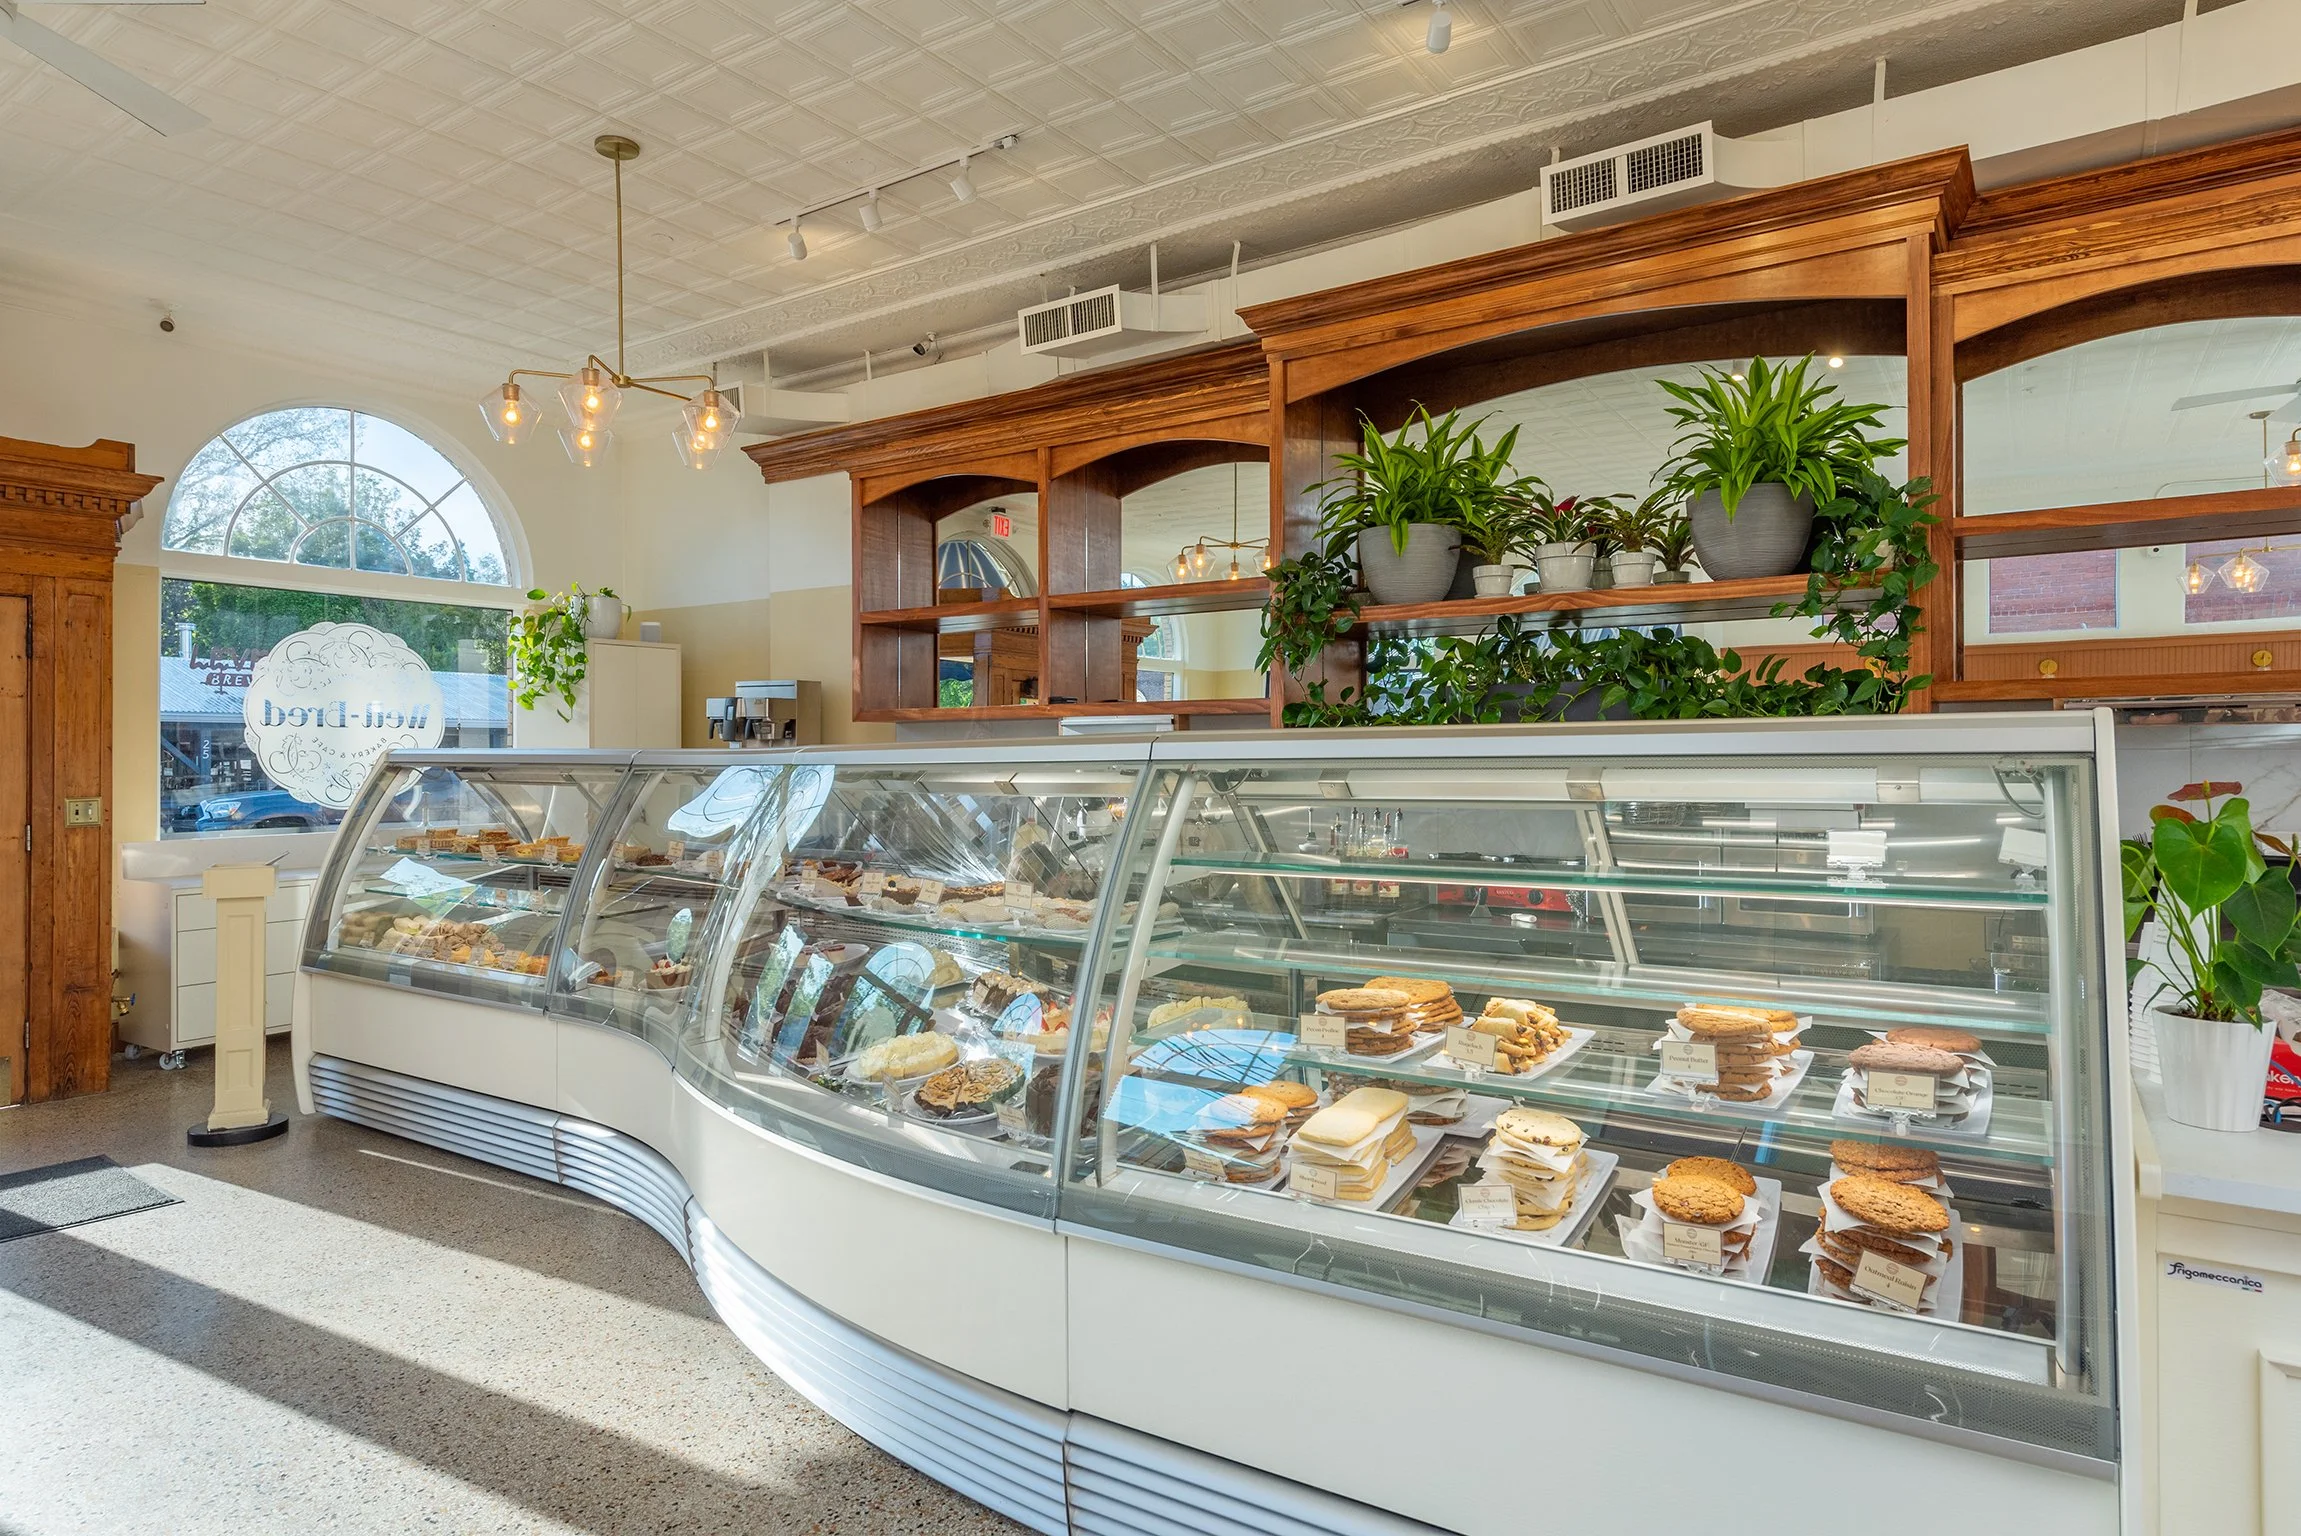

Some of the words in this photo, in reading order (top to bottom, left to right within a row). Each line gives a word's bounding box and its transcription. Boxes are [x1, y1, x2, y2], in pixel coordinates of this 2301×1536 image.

[1864, 1264, 1896, 1281] Oatmeal
[1894, 1276, 1918, 1291] Raisin
[2167, 1262, 2263, 1288] frigomeccanica
